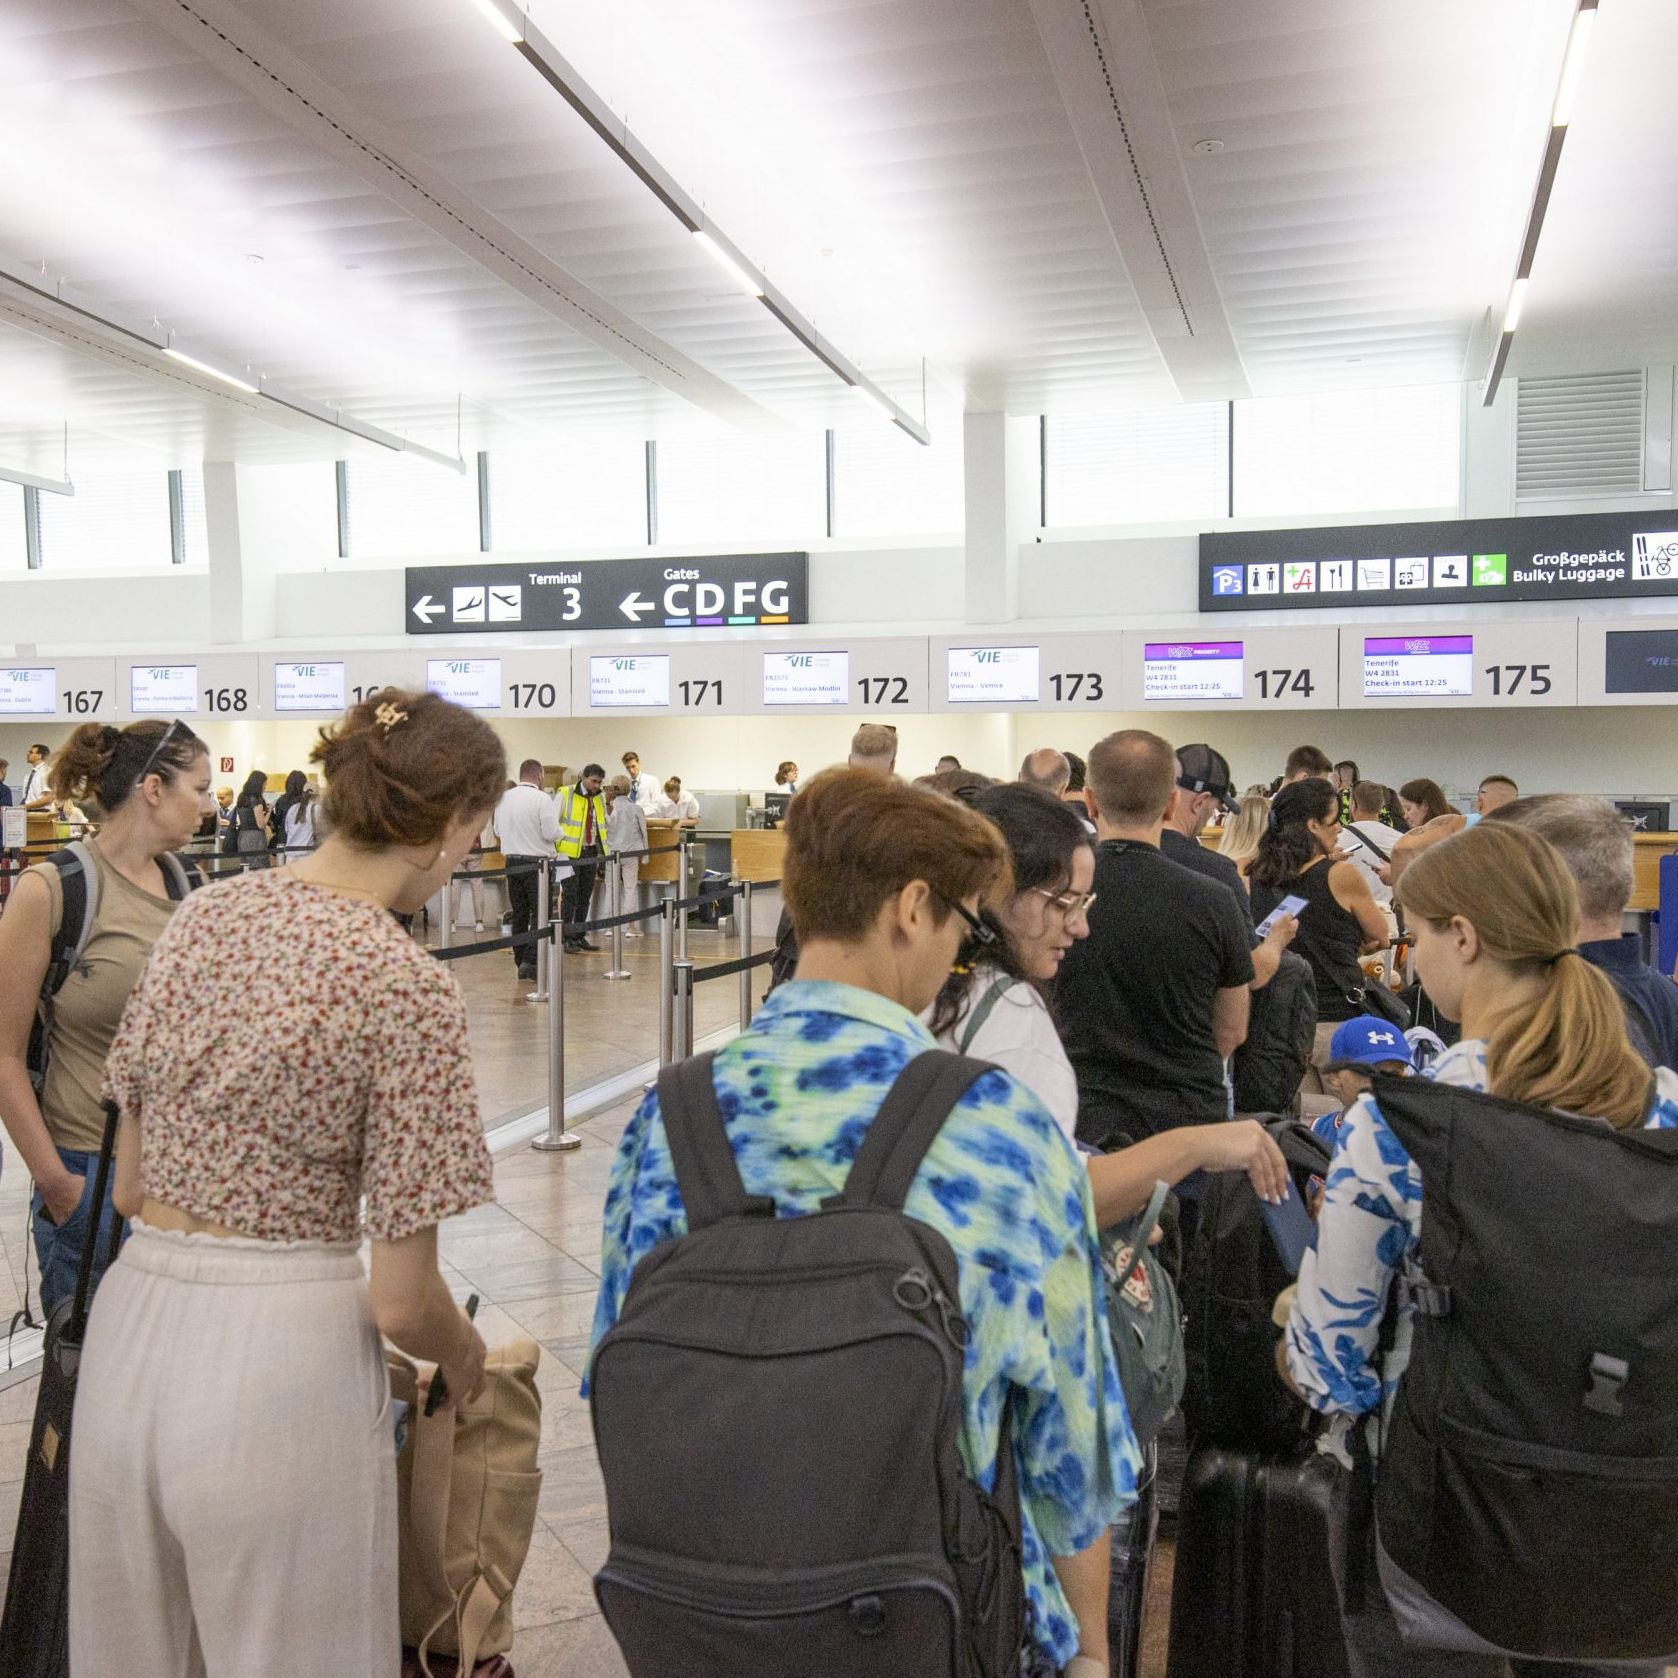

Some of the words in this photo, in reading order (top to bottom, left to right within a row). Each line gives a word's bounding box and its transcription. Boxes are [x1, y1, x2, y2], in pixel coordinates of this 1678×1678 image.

[1532, 550, 1625, 567] Großgepäck
[528, 571, 582, 585] Terminal
[663, 568, 700, 580] Gates
[1513, 569, 1555, 583] Bulky
[1559, 568, 1625, 583] Luggage
[562, 587, 582, 620] 3
[615, 659, 636, 670] VIE
[790, 656, 813, 667] VIE
[977, 651, 1001, 663] VIE
[153, 669, 170, 680] VIE
[297, 666, 316, 676] VIE
[451, 662, 471, 673] VIE
[12, 671, 29, 681] VIE
[1254, 668, 1315, 698] 174
[1485, 664, 1551, 696] 175
[678, 680, 722, 706] 171
[857, 677, 909, 704] 172
[1050, 673, 1104, 701] 173
[63, 690, 103, 713] 167
[204, 688, 248, 712] 168
[509, 683, 556, 708] 170
